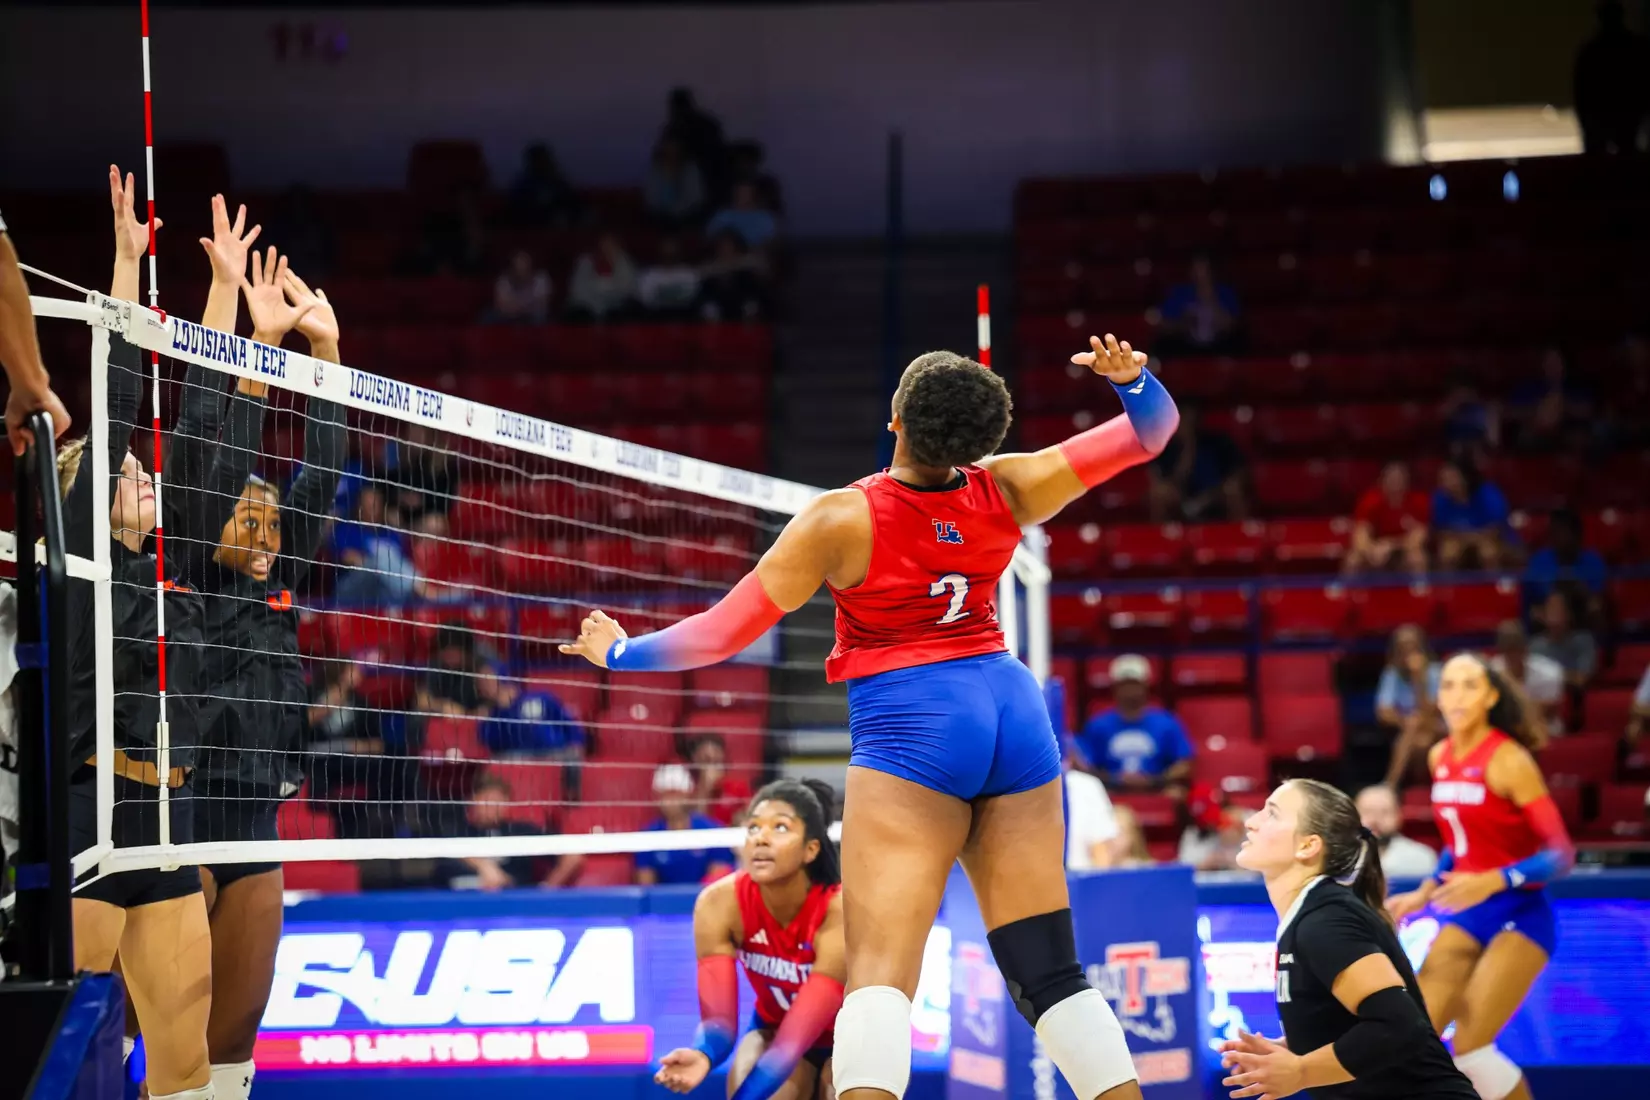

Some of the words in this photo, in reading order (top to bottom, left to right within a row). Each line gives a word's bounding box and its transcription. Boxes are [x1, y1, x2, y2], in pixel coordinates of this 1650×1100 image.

[172, 318, 247, 368] LOUISIANA
[253, 342, 288, 379] TECH
[350, 370, 411, 412] LOUISIANA
[416, 389, 444, 420] TECH
[930, 572, 972, 625] 2
[354, 1032, 479, 1063] LIMITS
